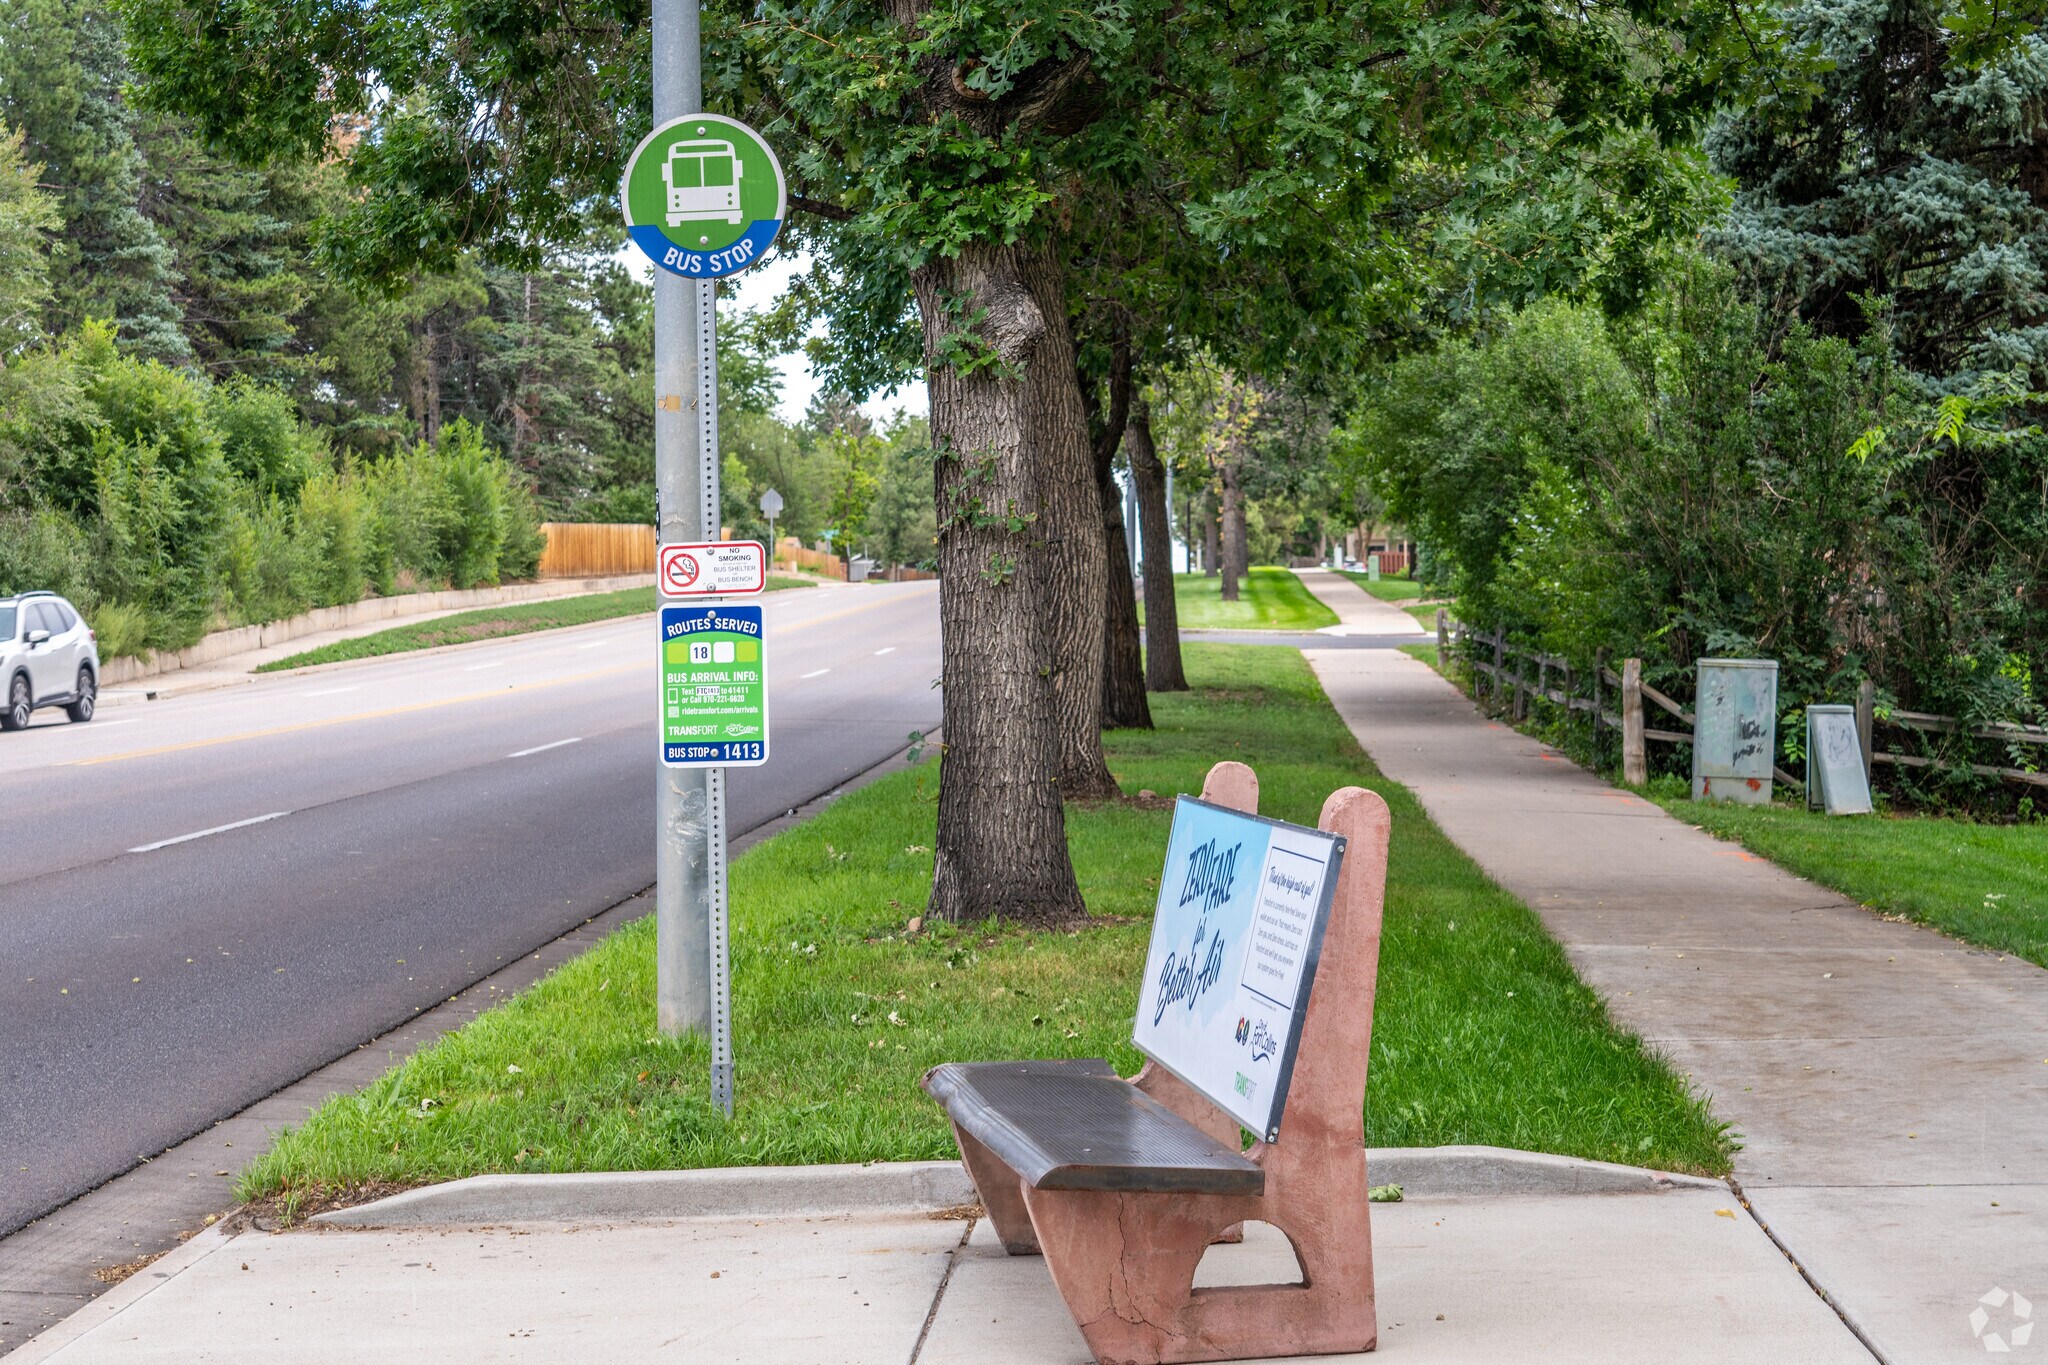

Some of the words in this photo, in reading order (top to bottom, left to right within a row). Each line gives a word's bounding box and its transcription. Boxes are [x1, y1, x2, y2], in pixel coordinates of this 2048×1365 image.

[663, 246, 702, 273] BUS
[709, 238, 753, 272] STOP
[718, 554, 751, 562] SMOKING
[667, 618, 711, 637] ROUTES
[714, 618, 758, 635] SERVED
[693, 646, 708, 659] 18
[667, 673, 688, 683] BUS
[690, 671, 731, 682] ARRIVAL
[733, 671, 759, 682] INFO:
[681, 687, 695, 695] Text
[721, 686, 728, 694] to
[728, 686, 749, 694] 41411
[668, 725, 718, 736] TRANSFORT
[668, 748, 686, 758] BUS
[688, 747, 710, 758] STOP
[723, 743, 760, 759] 1413
[1179, 837, 1215, 908] ZERO
[1203, 842, 1242, 914] FARE
[1191, 916, 1207, 957] for
[1154, 951, 1197, 1028] Better
[1188, 929, 1225, 1011] Air
[1253, 1026, 1264, 1048] Fort
[1261, 1031, 1277, 1056] Collins
[1234, 1071, 1257, 1102] TRANSFORT
